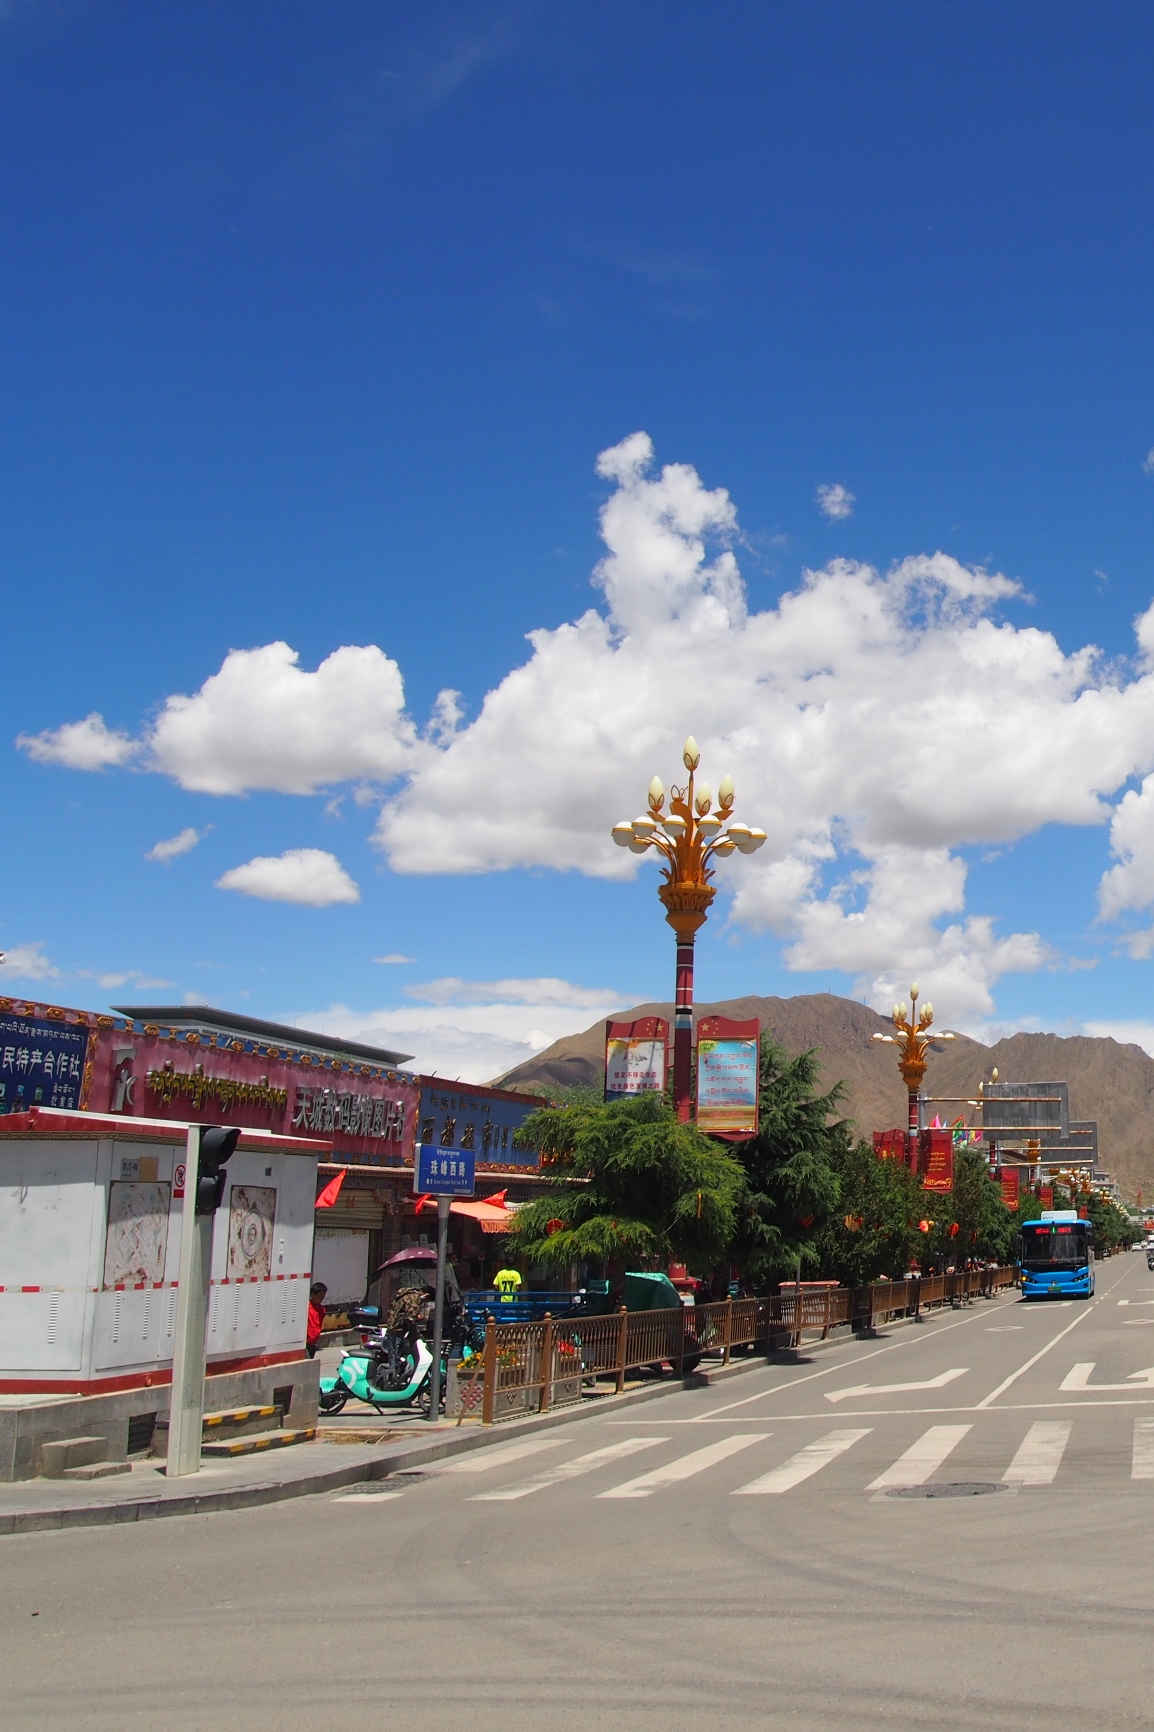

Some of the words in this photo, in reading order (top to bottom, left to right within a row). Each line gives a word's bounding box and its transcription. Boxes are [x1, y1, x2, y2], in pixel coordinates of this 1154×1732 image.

[0, 1046, 80, 1081] 民特产合作社
[431, 1160, 465, 1176] 珠峰西路
[502, 1281, 514, 1293] 77
